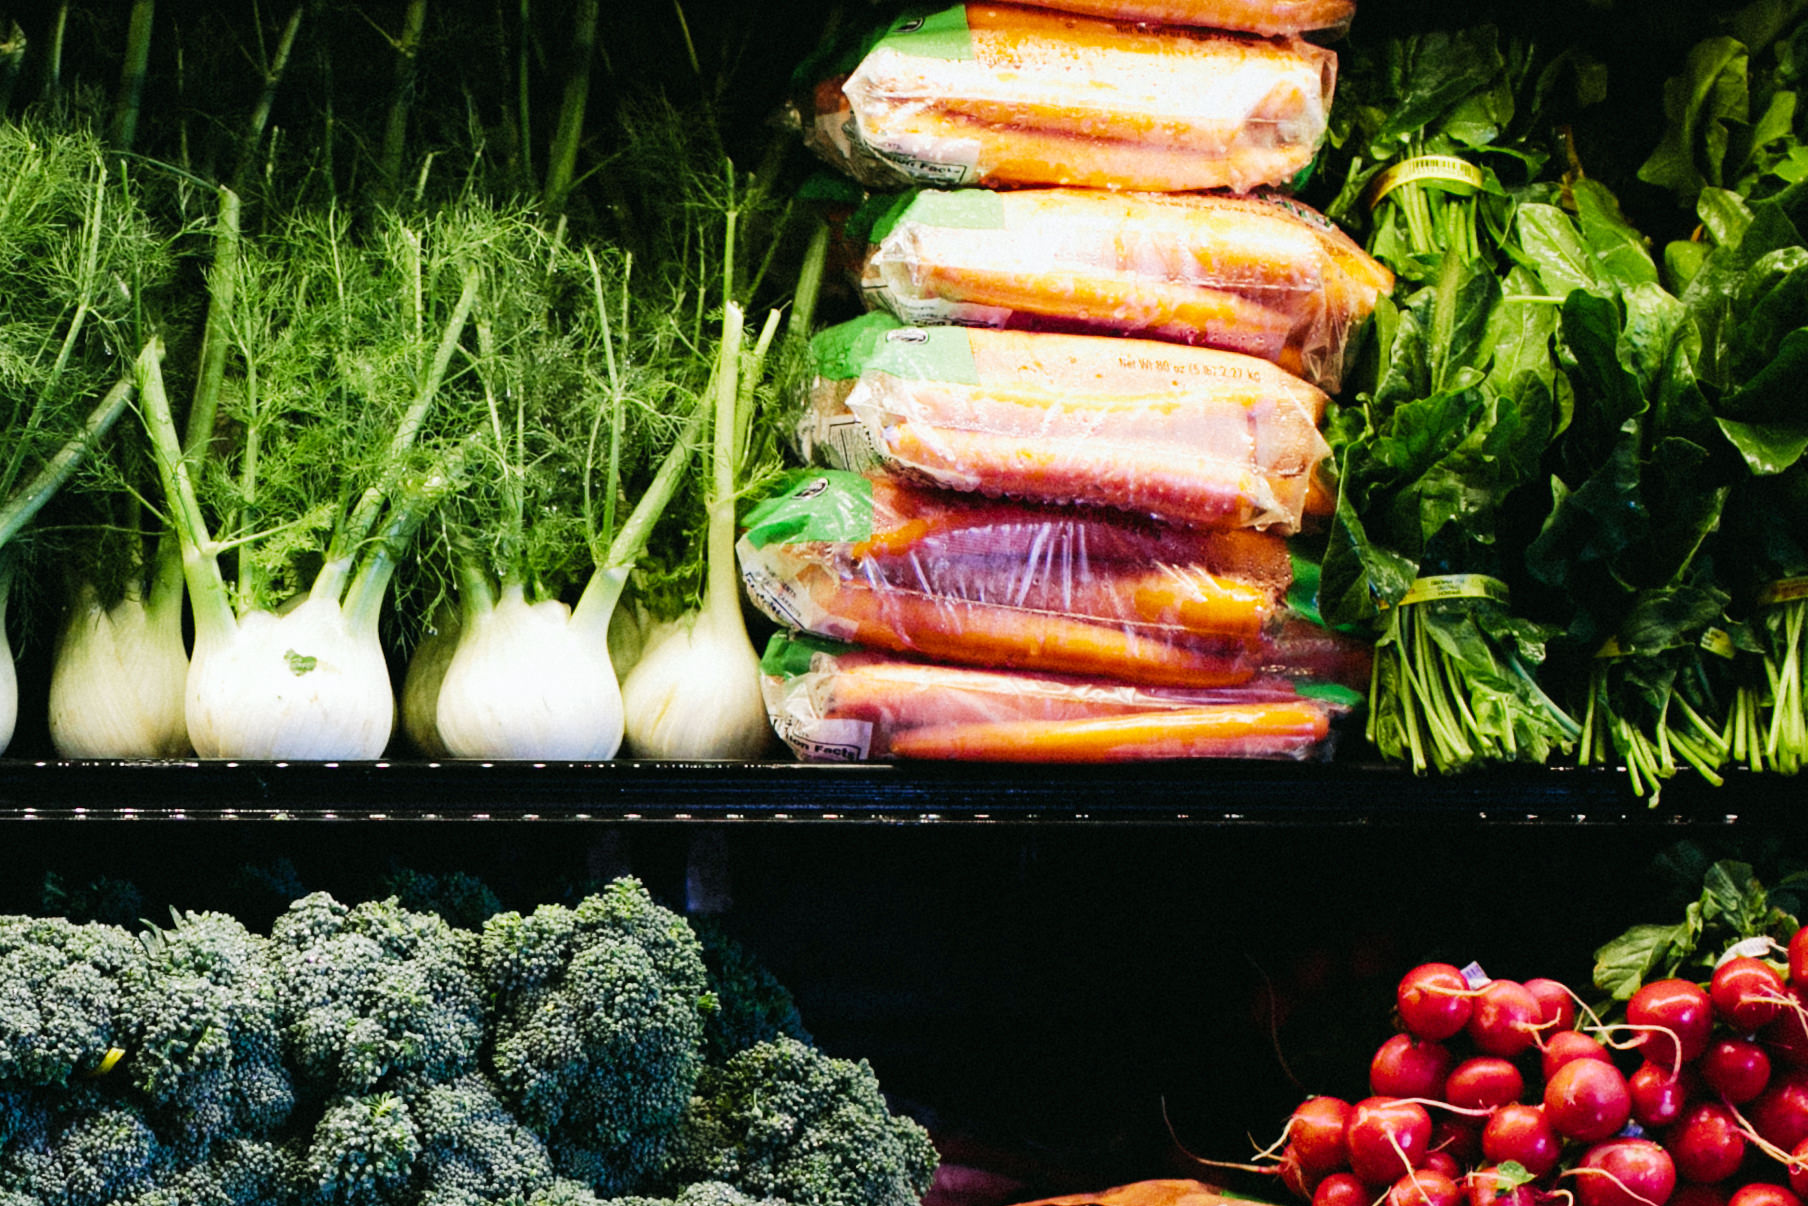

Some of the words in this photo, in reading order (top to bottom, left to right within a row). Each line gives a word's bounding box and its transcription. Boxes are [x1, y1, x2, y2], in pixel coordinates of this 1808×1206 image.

[1119, 357, 1135, 368] Net
[1139, 359, 1153, 370] Wt
[1173, 364, 1186, 374] oz
[814, 745, 855, 760] Facts
